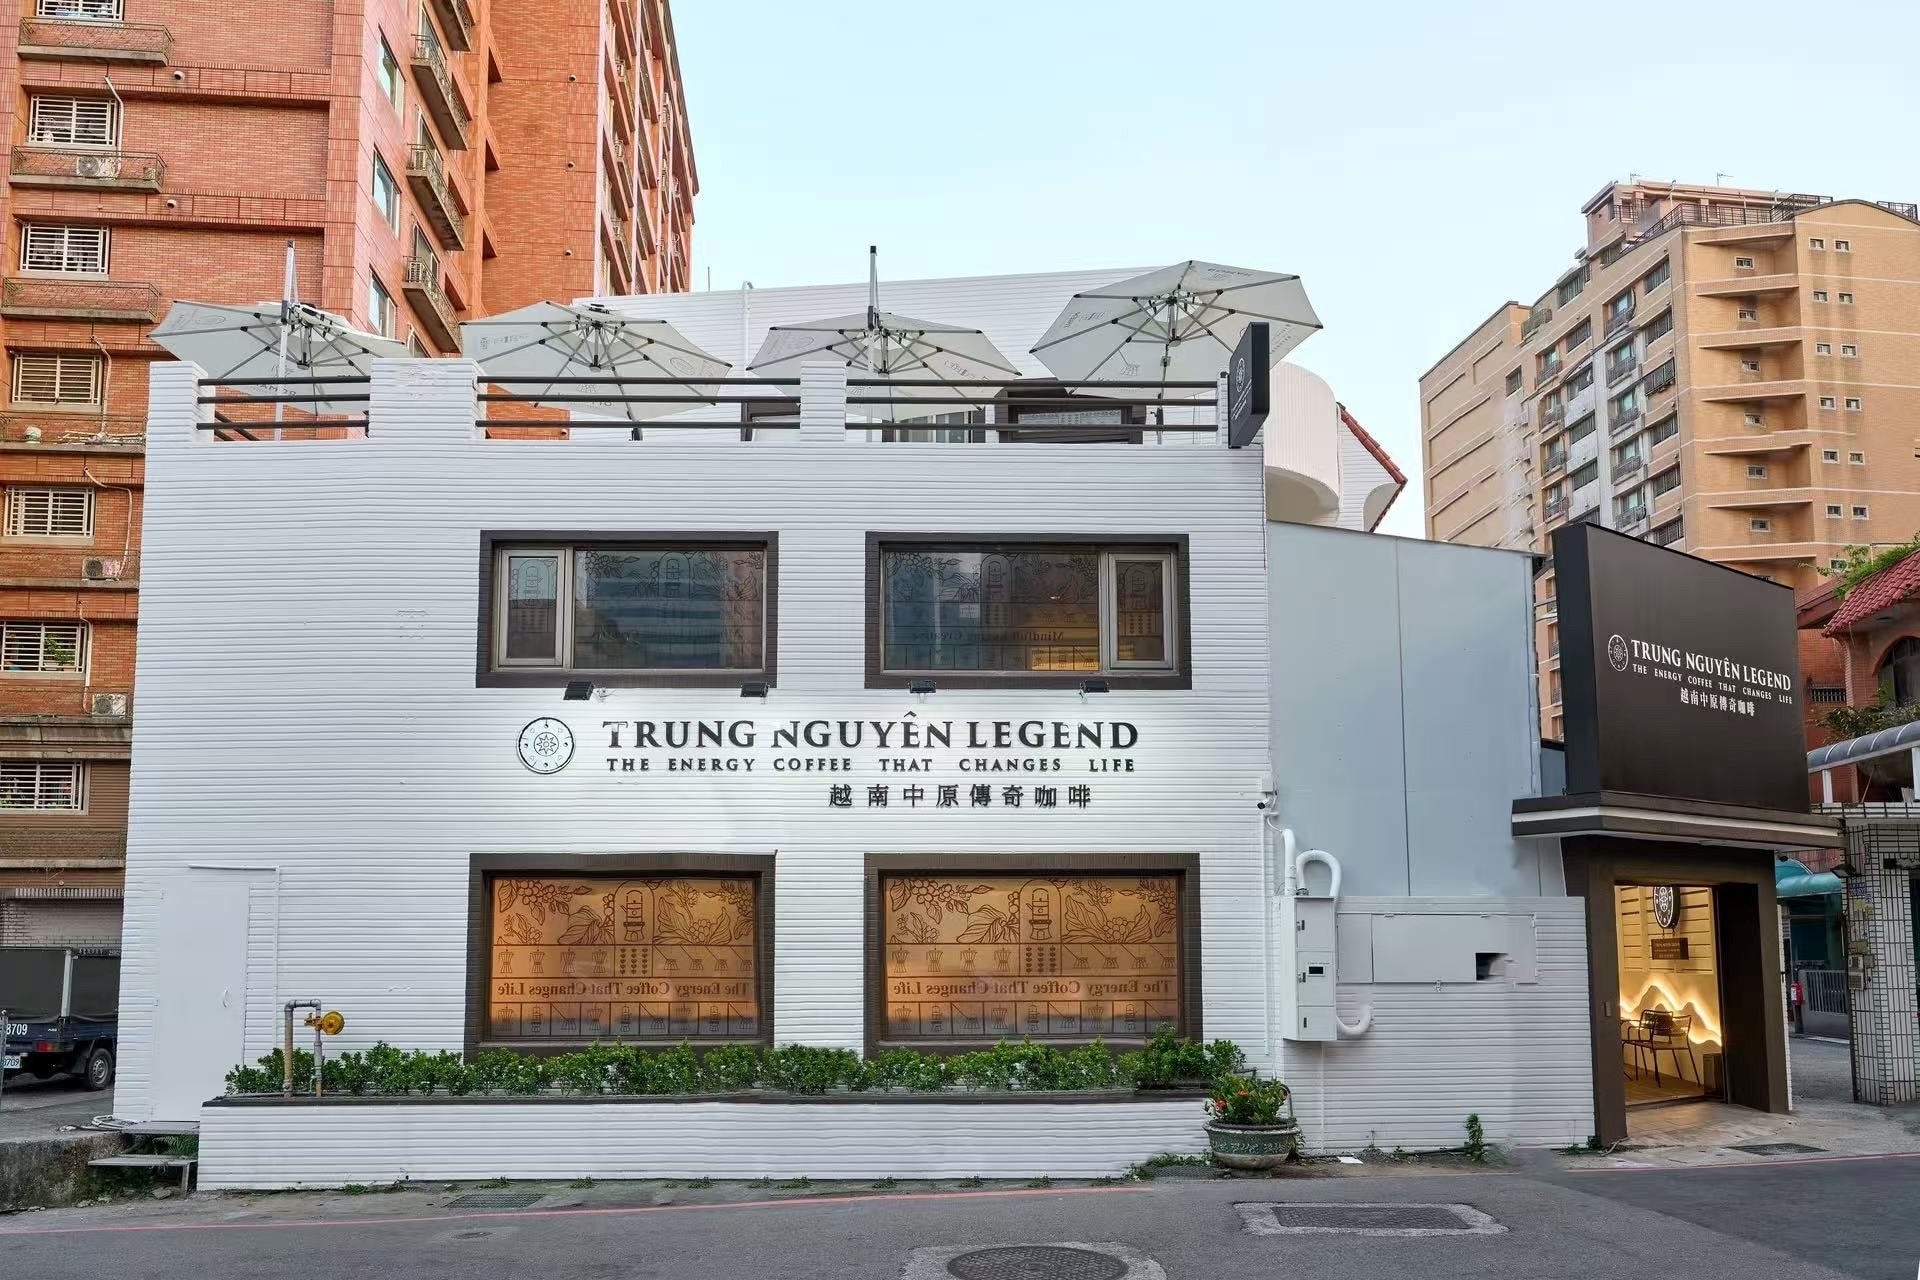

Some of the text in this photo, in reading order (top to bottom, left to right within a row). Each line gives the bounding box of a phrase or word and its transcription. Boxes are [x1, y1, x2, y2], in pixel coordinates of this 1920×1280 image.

[1631, 639, 1791, 691] TRUNG NGUYÊN LEGEND
[1632, 663, 1793, 705] THE ENERGY COFFEE THAT CHANGES LIFE
[1680, 687, 1755, 717] 越南中原傳奇咖啡
[602, 711, 1139, 750] TRUNG NGUYÊN LEGEND
[606, 757, 1135, 773] THE ENERGY COFFEE THAT CHANGES LIFE
[828, 783, 1092, 809] 越南中原傳奇咖啡
